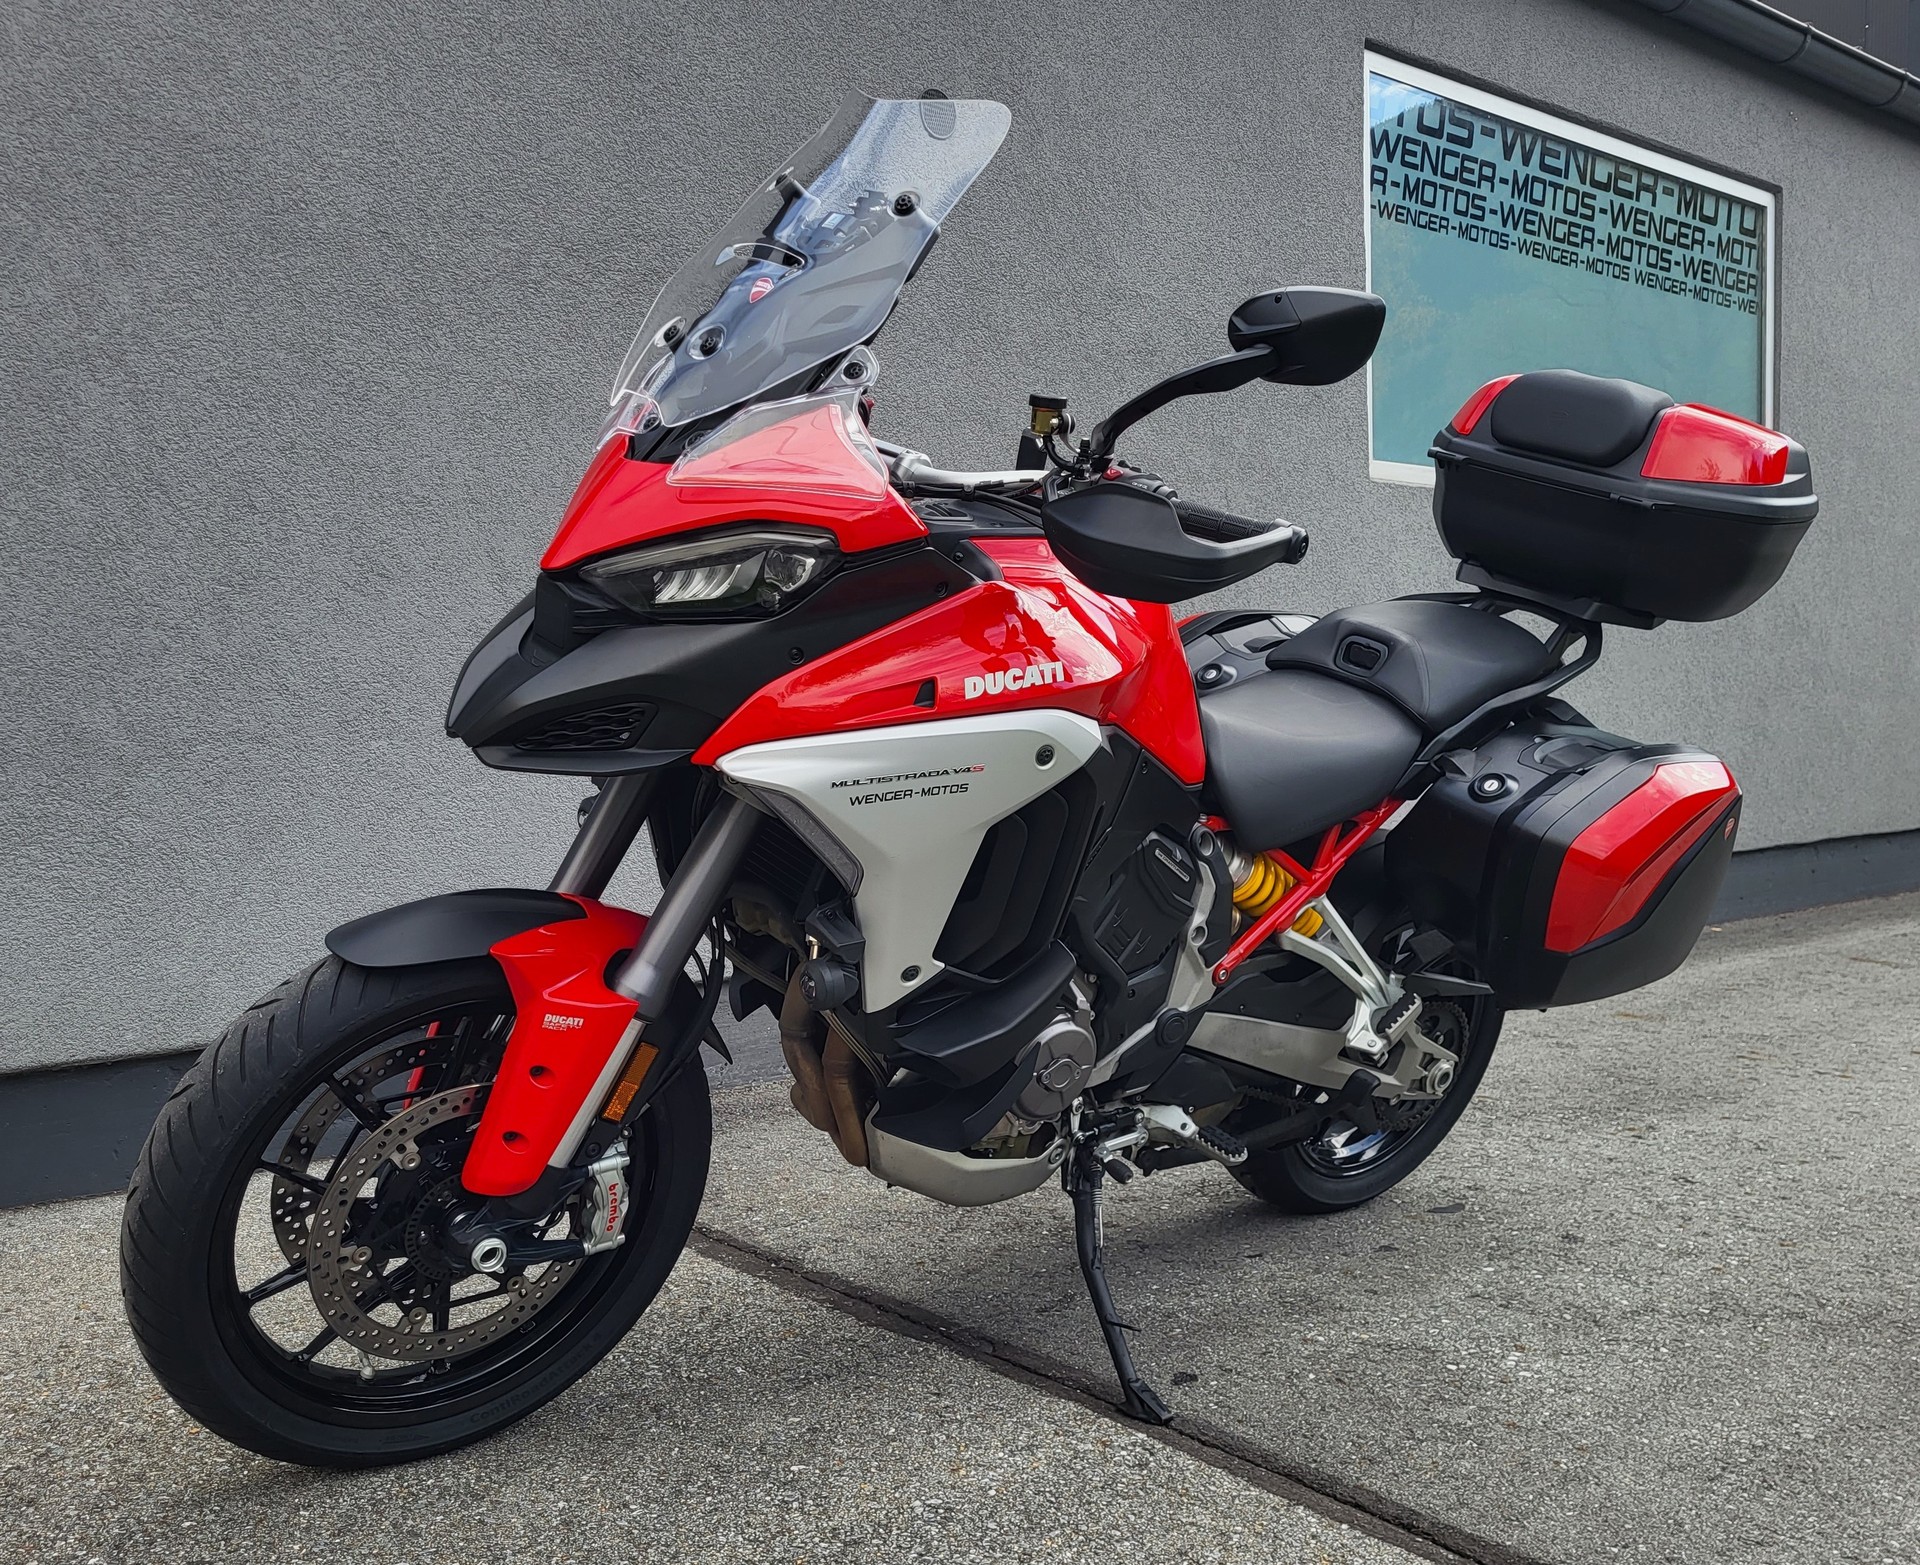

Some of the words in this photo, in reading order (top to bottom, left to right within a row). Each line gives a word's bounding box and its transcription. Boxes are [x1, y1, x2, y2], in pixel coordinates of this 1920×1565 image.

[964, 661, 1063, 699] DUCATI
[831, 769, 950, 789] MULTISTRADA
[849, 783, 969, 806] WENGER-MOTOS
[544, 1013, 584, 1026] DUCATI
[607, 1183, 619, 1231] brembo
